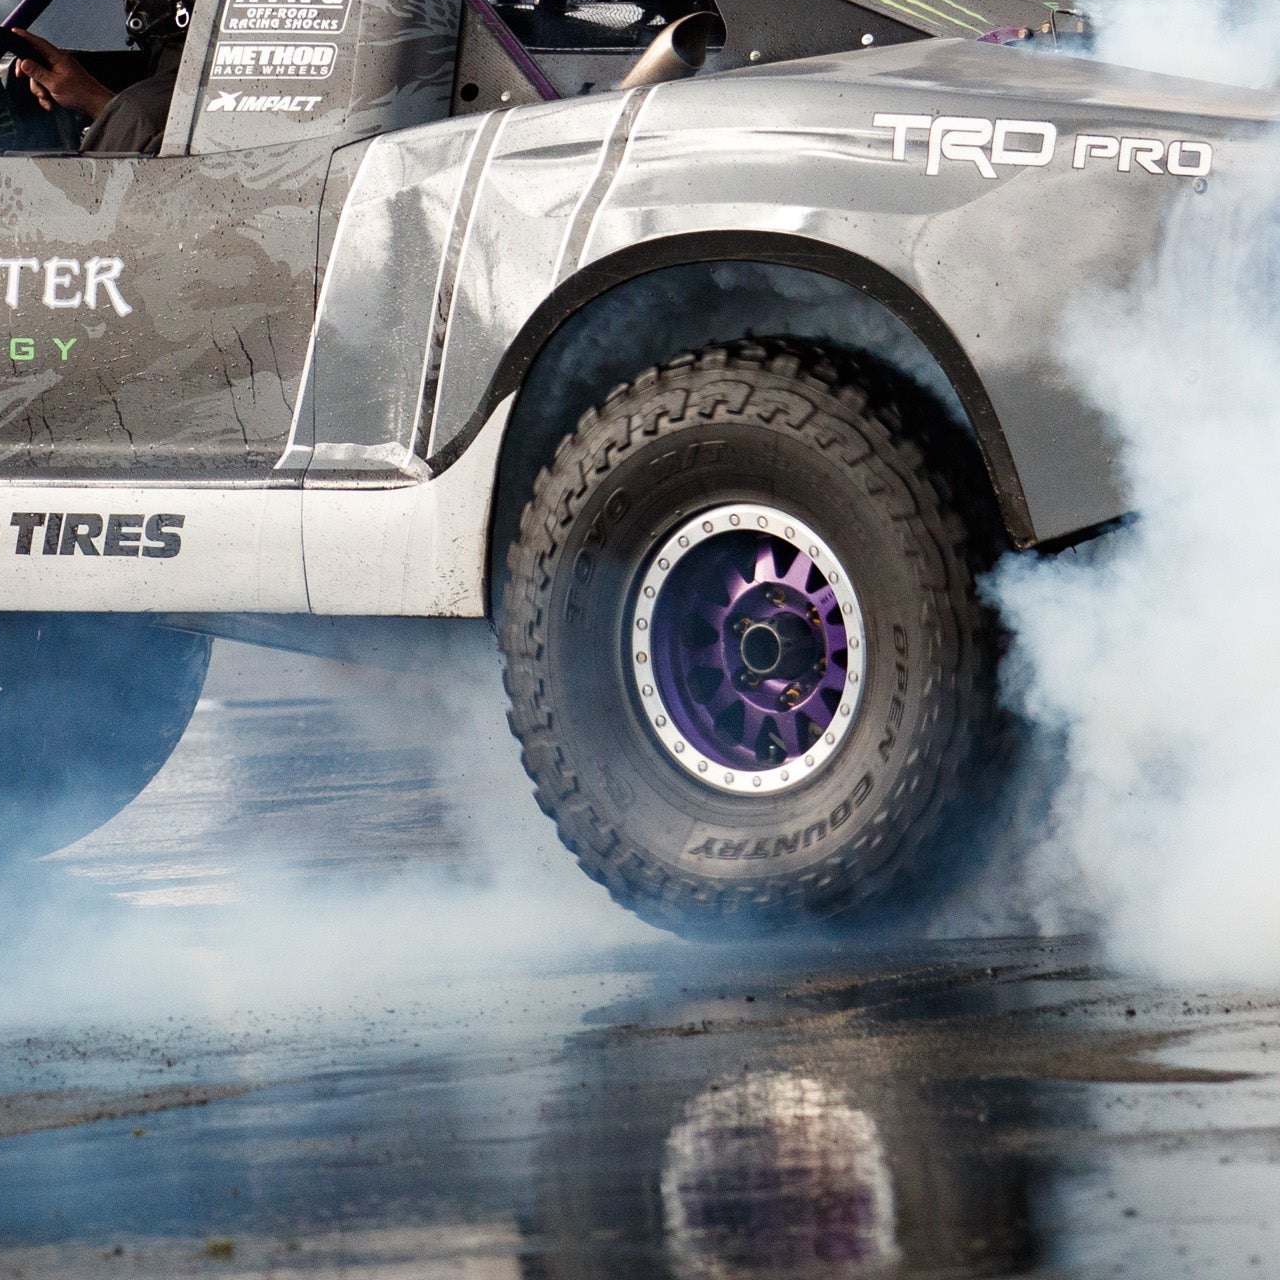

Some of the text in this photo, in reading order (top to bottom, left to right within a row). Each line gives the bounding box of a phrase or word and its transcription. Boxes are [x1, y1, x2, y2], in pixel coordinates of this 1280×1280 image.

[228, 18, 339, 30] RACING SHOCKS
[246, 8, 319, 19] OFF-ROAD
[215, 45, 334, 66] METHOD
[213, 65, 330, 76] RACE WHEELS
[872, 112, 1214, 180] TRD PRO
[10, 511, 186, 559] TIRES
[691, 622, 910, 860] OPEN COUNTRY
